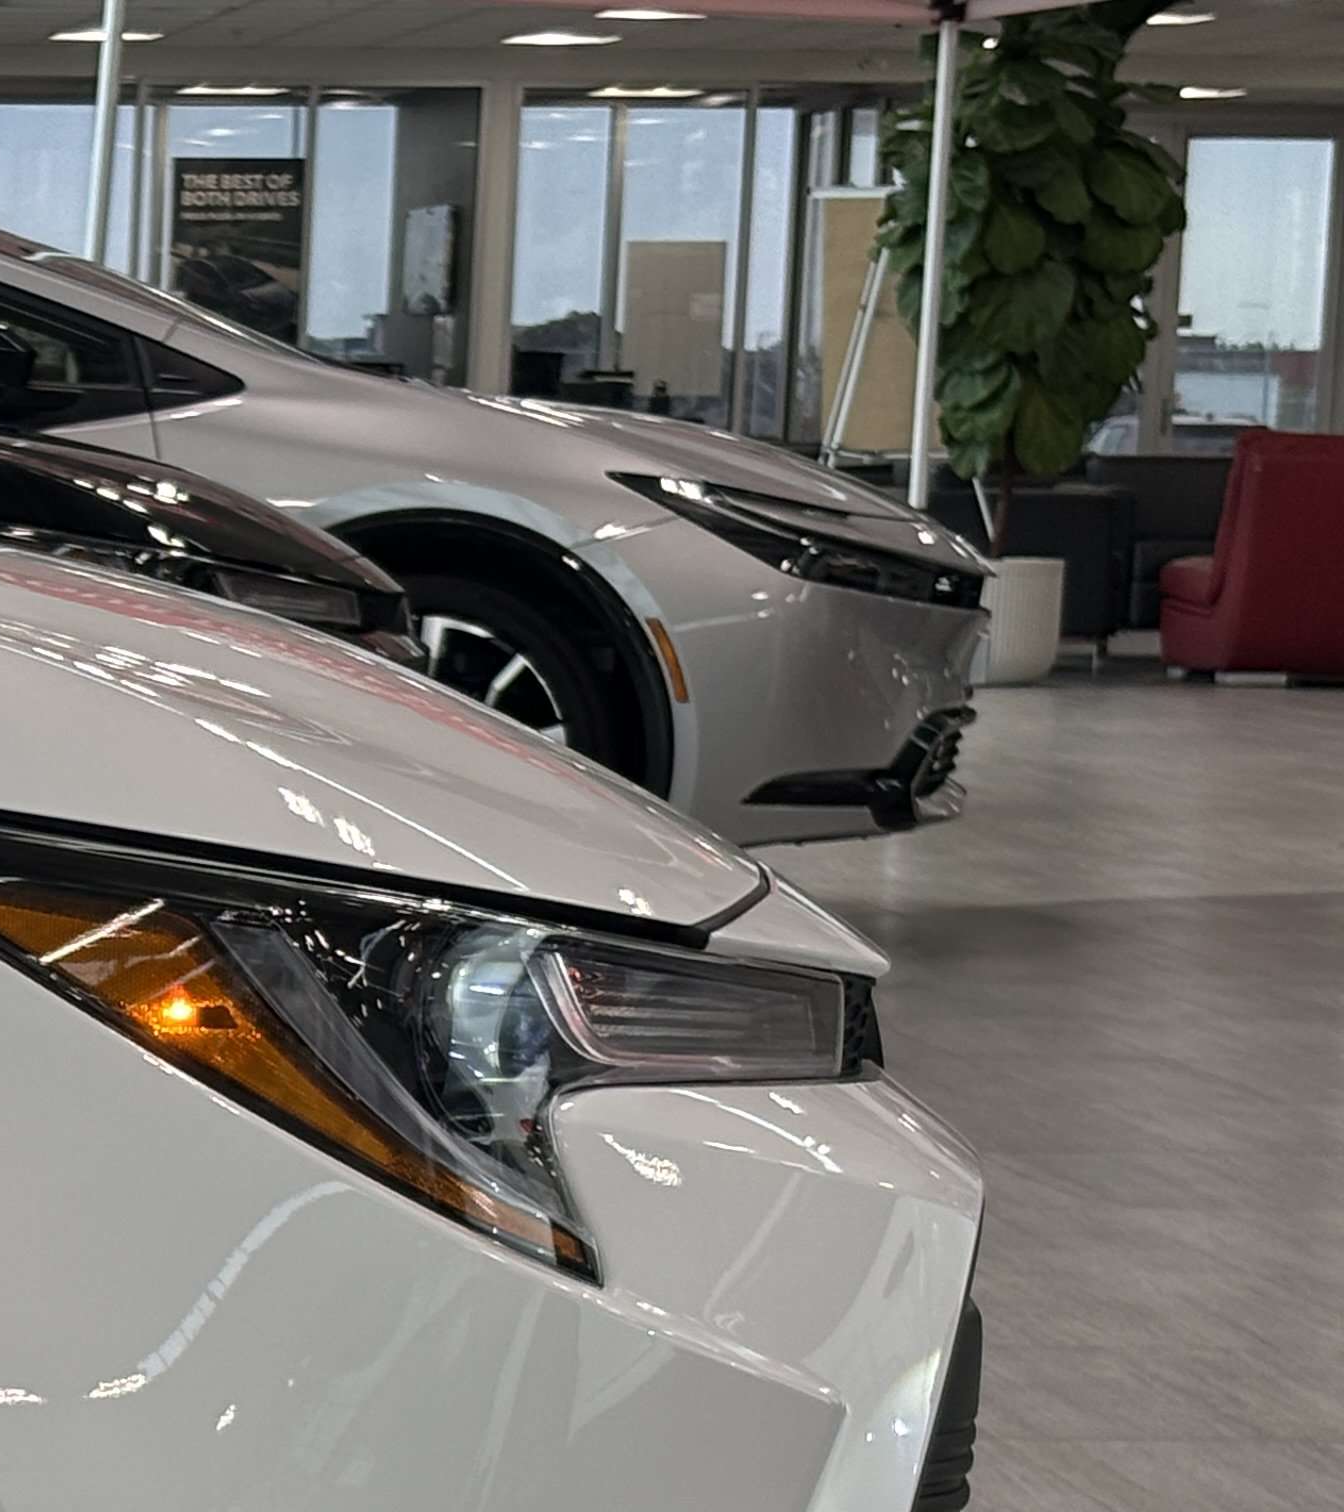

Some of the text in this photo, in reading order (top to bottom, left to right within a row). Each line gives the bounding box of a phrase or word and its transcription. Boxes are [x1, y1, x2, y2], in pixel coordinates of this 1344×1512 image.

[181, 173, 293, 190] THE BEST OF
[181, 191, 301, 207] BOTH DRIVES
